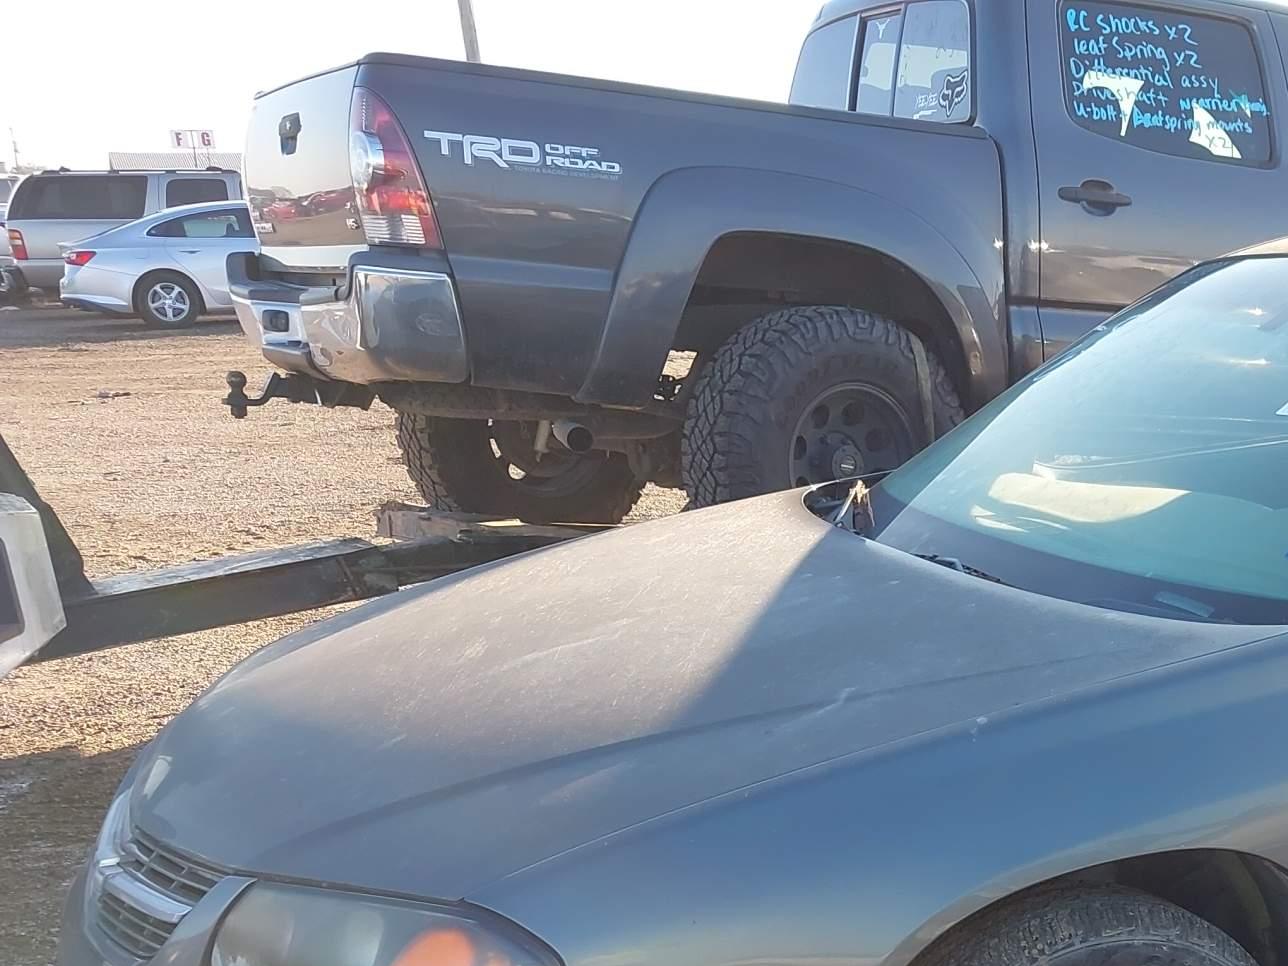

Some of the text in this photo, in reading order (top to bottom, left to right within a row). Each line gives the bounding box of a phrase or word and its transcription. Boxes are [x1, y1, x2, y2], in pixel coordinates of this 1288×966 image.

[175, 131, 212, 147] F G
[423, 129, 541, 169] TRD
[545, 143, 600, 158] OFF
[545, 154, 622, 174] ROAD
